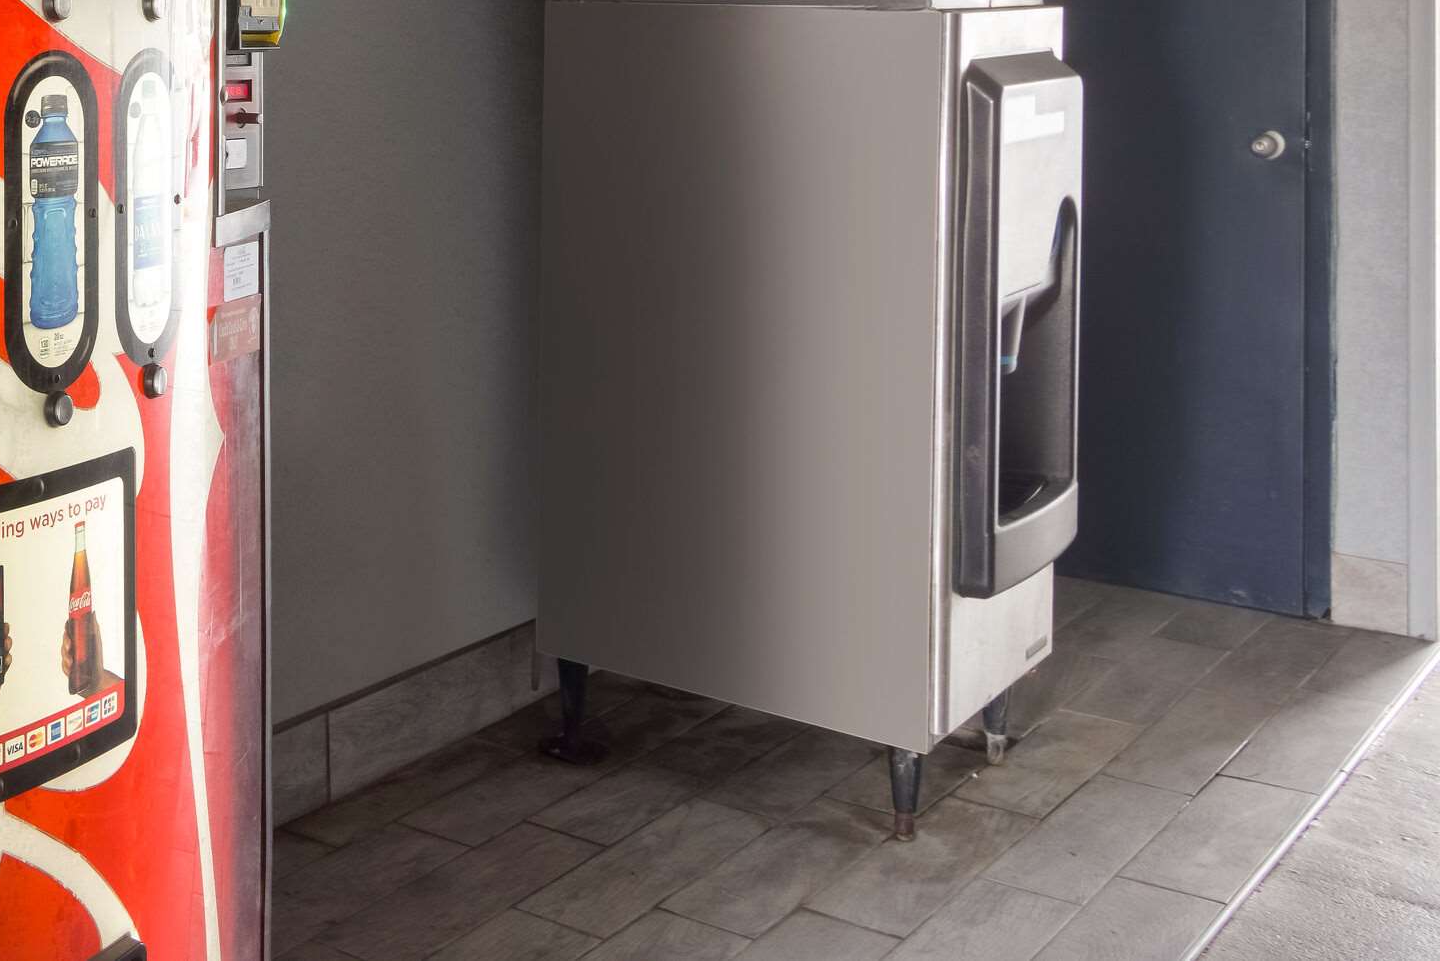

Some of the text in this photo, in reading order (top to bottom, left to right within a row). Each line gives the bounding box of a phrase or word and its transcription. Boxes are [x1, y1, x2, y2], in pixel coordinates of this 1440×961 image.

[30, 155, 78, 168] POWERADE
[29, 507, 64, 530] ways
[68, 502, 81, 519] to
[85, 494, 106, 515] pay
[7, 742, 23, 755] VISA
